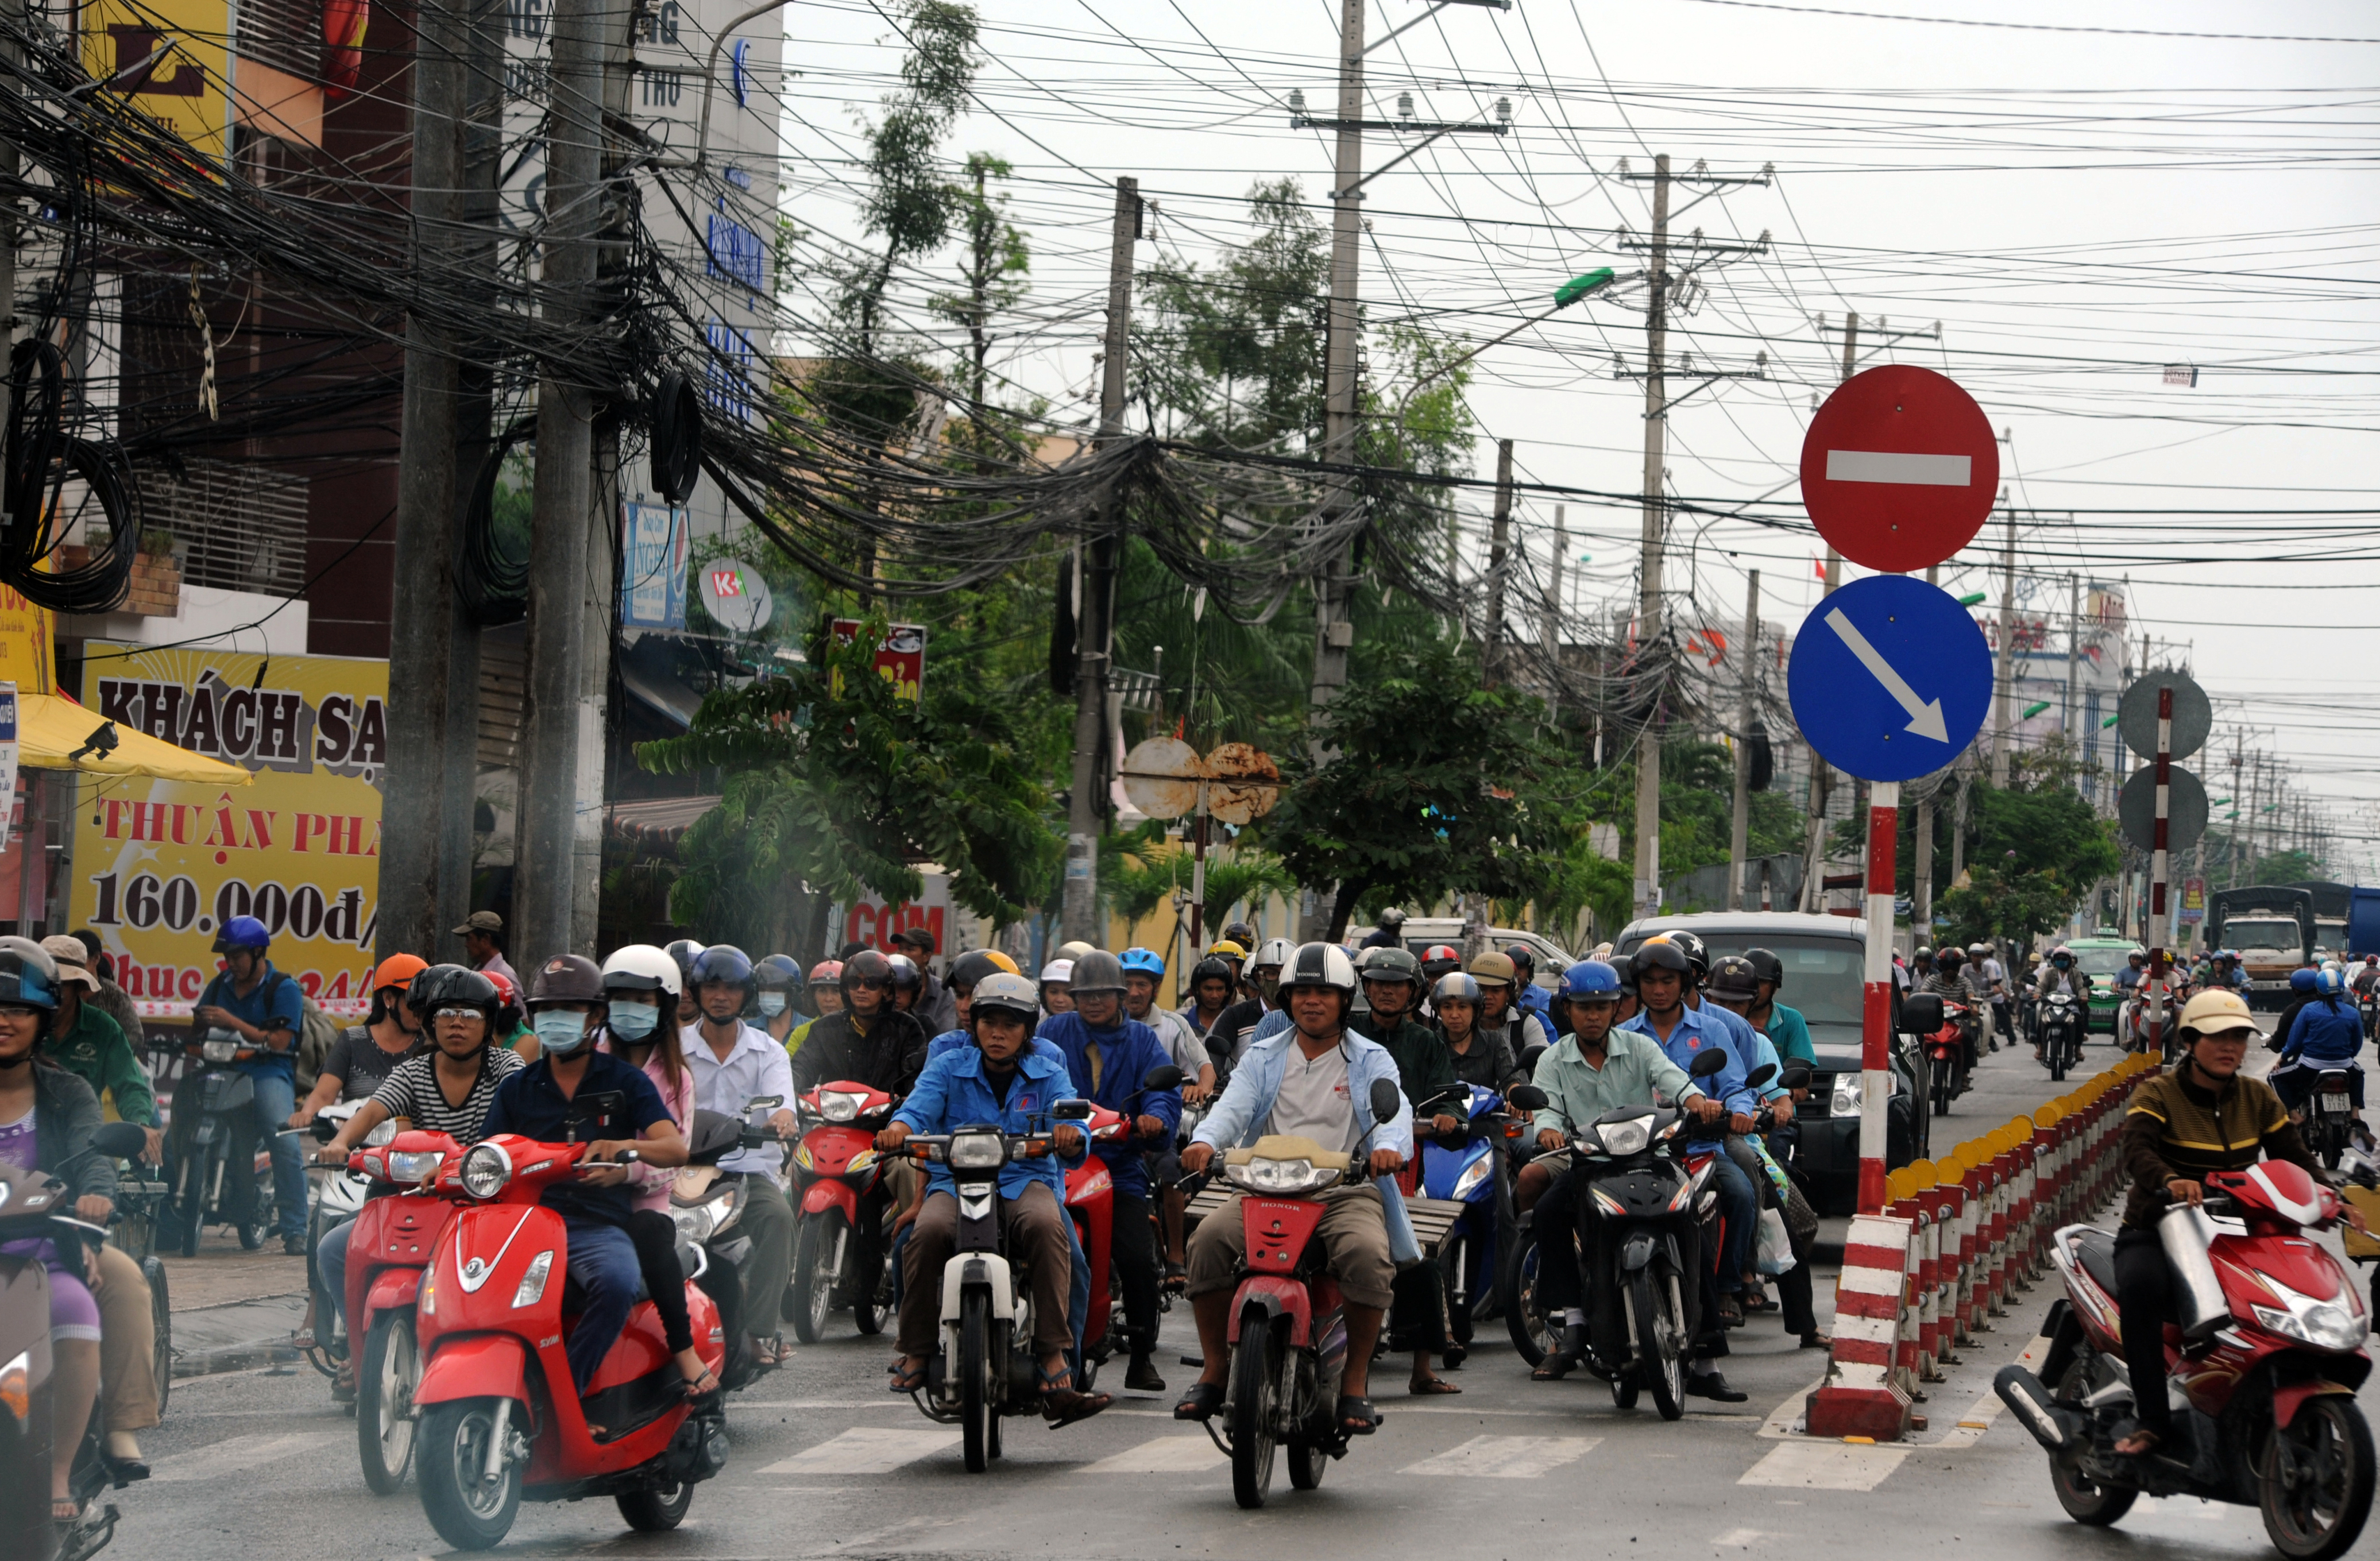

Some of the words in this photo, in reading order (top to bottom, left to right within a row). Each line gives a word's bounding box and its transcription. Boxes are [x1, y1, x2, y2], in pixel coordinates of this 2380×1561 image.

[713, 573, 743, 596] K+
[97, 666, 303, 764] KHÁCH
[98, 791, 277, 865] THUẬN
[1261, 1201, 1300, 1212] HONOR
[540, 1333, 560, 1349] SYM
